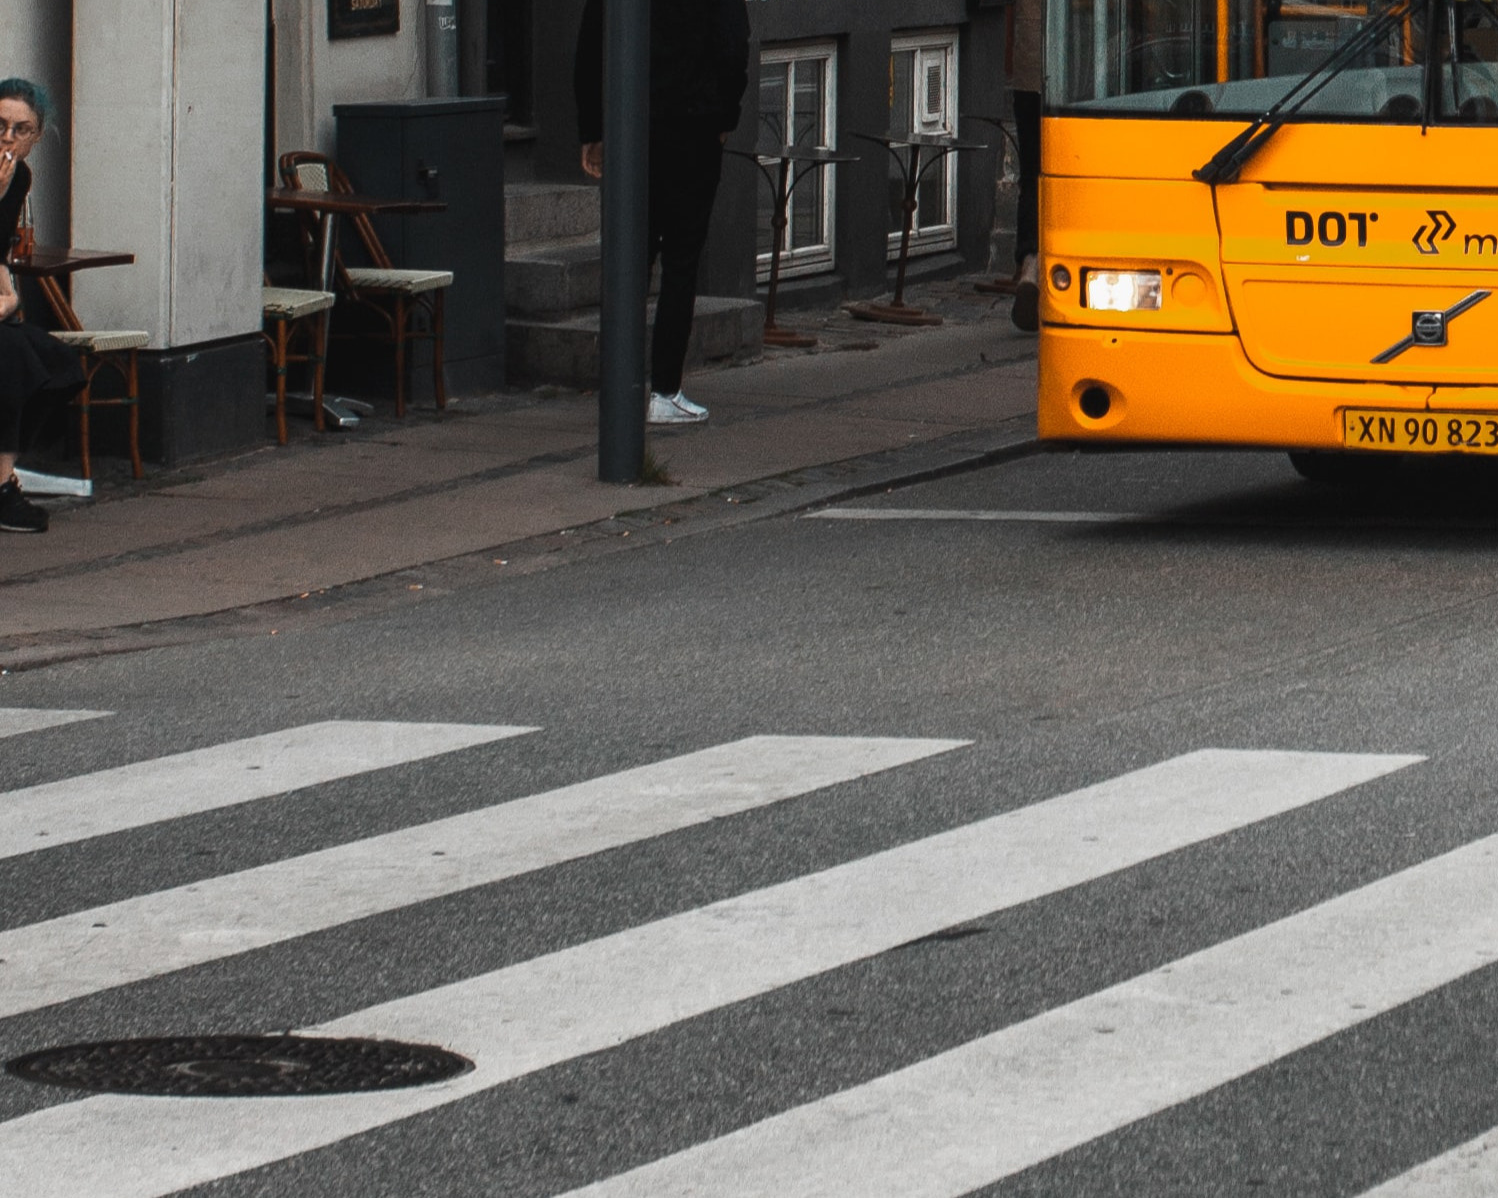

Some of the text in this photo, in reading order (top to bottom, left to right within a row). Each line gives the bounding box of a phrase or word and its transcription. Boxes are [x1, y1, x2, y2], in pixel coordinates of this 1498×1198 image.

[1286, 210, 1379, 247] DOT
[1359, 416, 1395, 444] XN
[1404, 418, 1438, 445] 90
